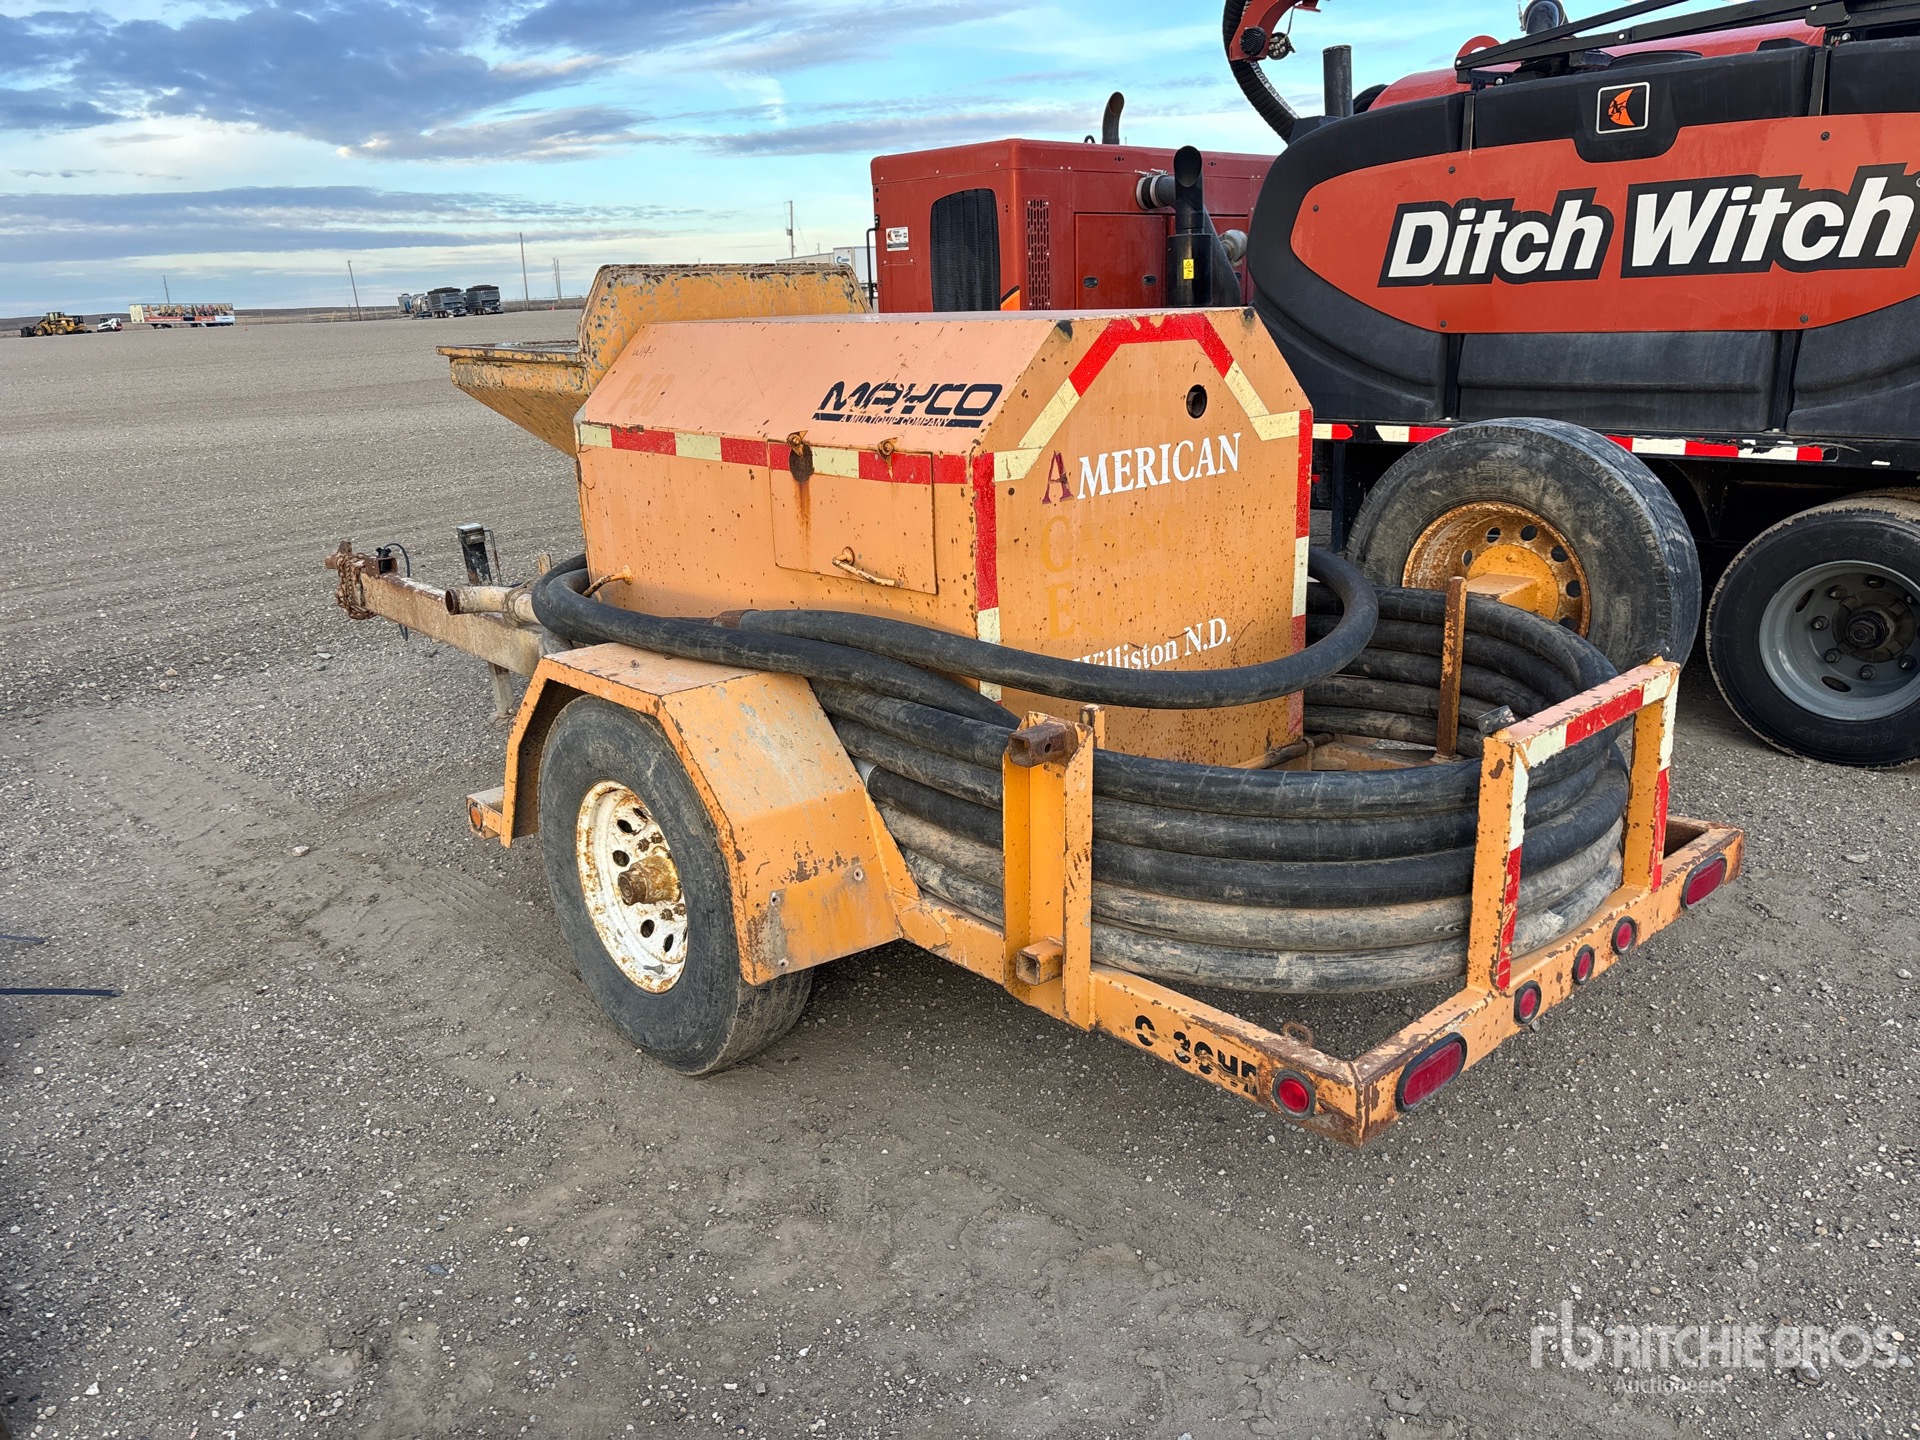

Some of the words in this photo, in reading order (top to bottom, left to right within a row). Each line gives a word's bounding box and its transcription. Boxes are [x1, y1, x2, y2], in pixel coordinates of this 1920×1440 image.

[1387, 198, 1605, 279] Ditch
[1631, 176, 1915, 269] Witch
[817, 380, 1004, 417] MAYCO
[901, 416, 951, 428] COMPANY
[1041, 431, 1242, 505] AMERICAN
[1184, 617, 1232, 657] N.D.
